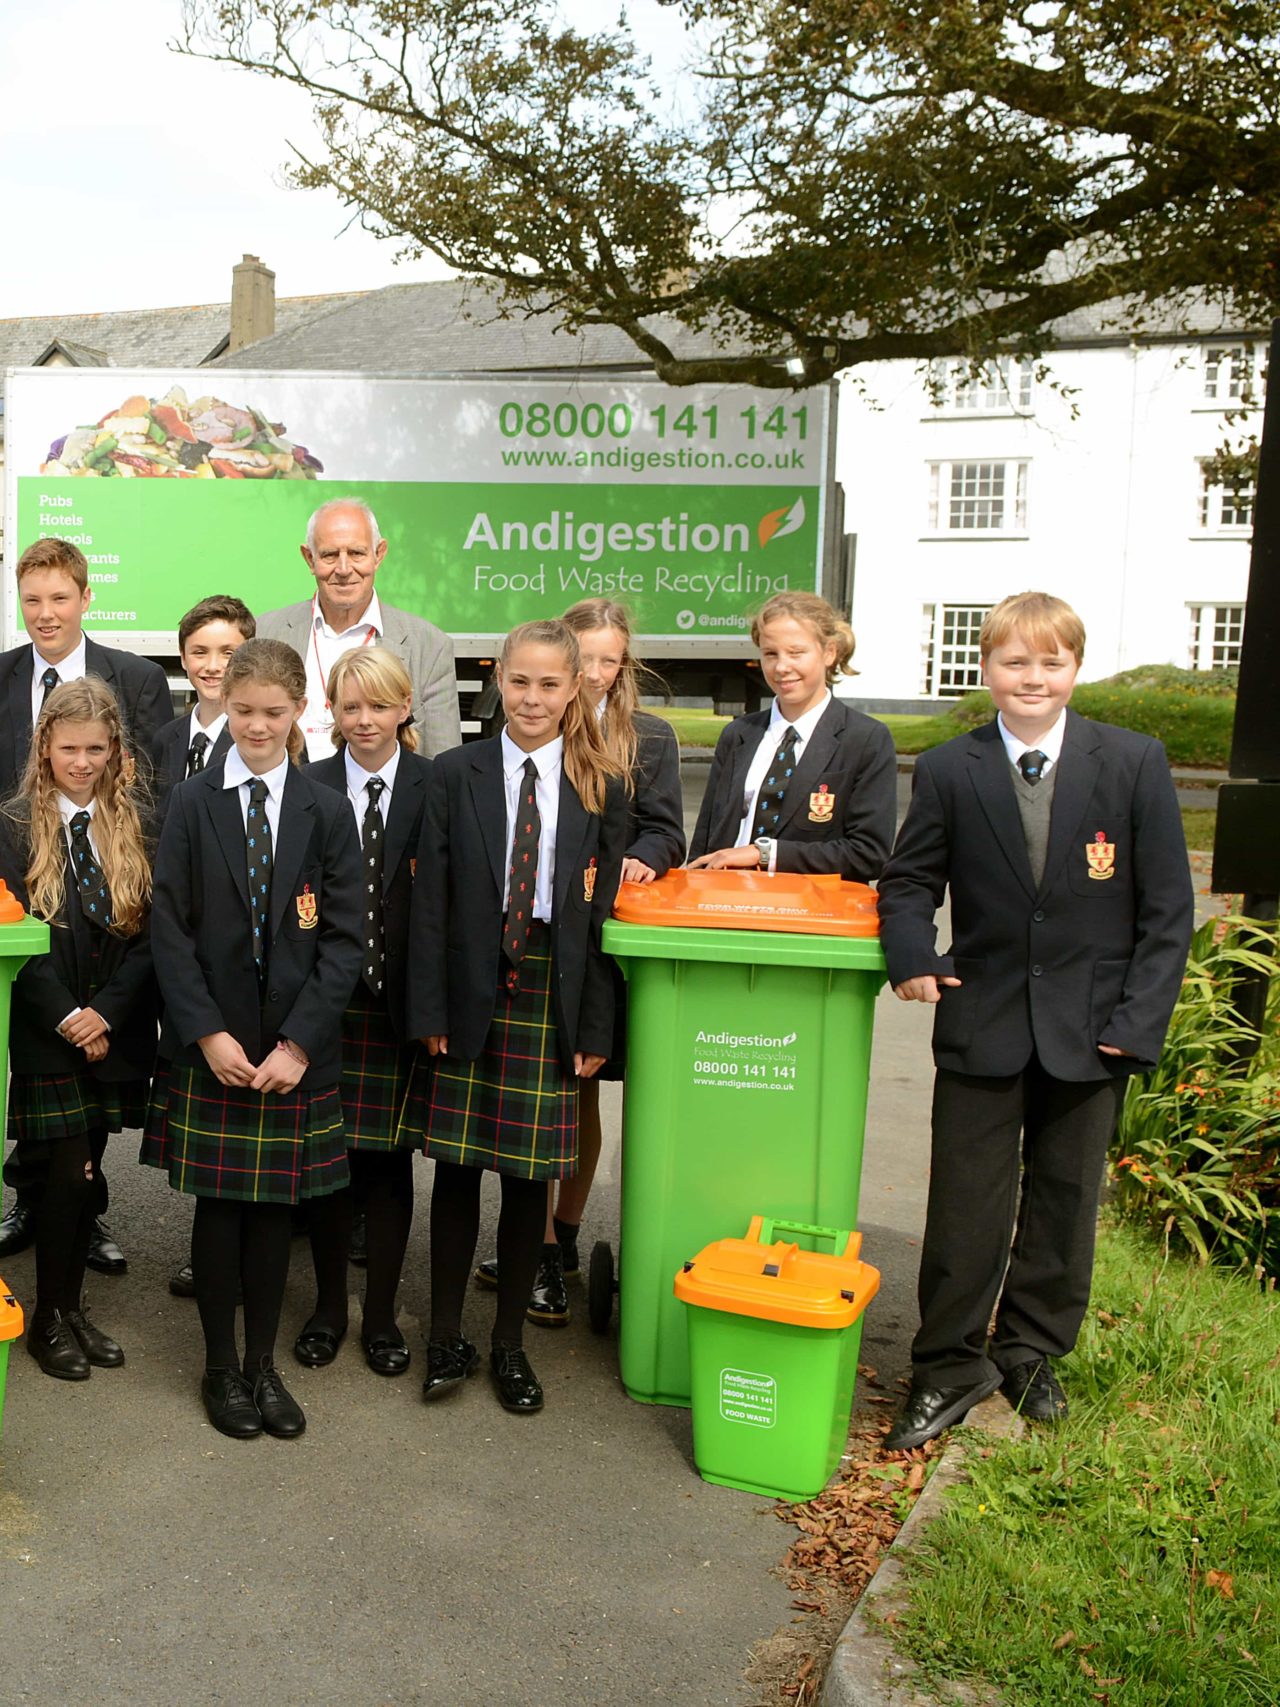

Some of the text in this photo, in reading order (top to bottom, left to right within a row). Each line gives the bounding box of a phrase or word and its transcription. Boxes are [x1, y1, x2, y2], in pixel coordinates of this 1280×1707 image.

[499, 401, 808, 440] 08000 141 141
[501, 447, 805, 472] www.andigestion.co.uk
[39, 494, 73, 507] Pubs
[39, 513, 84, 526] Hotels
[39, 532, 93, 545] Shools
[462, 511, 750, 562] Andigestion
[474, 562, 789, 602] Food Waste Recycling
[695, 1030, 782, 1048] Andigestion
[694, 1060, 796, 1078] 08000 141 141
[693, 1078, 794, 1090] www.andigestion.co.uk
[724, 1374, 766, 1387] Andigestion
[722, 1389, 772, 1404] 08000 141 141
[726, 1408, 770, 1424] FOOD WASTE
